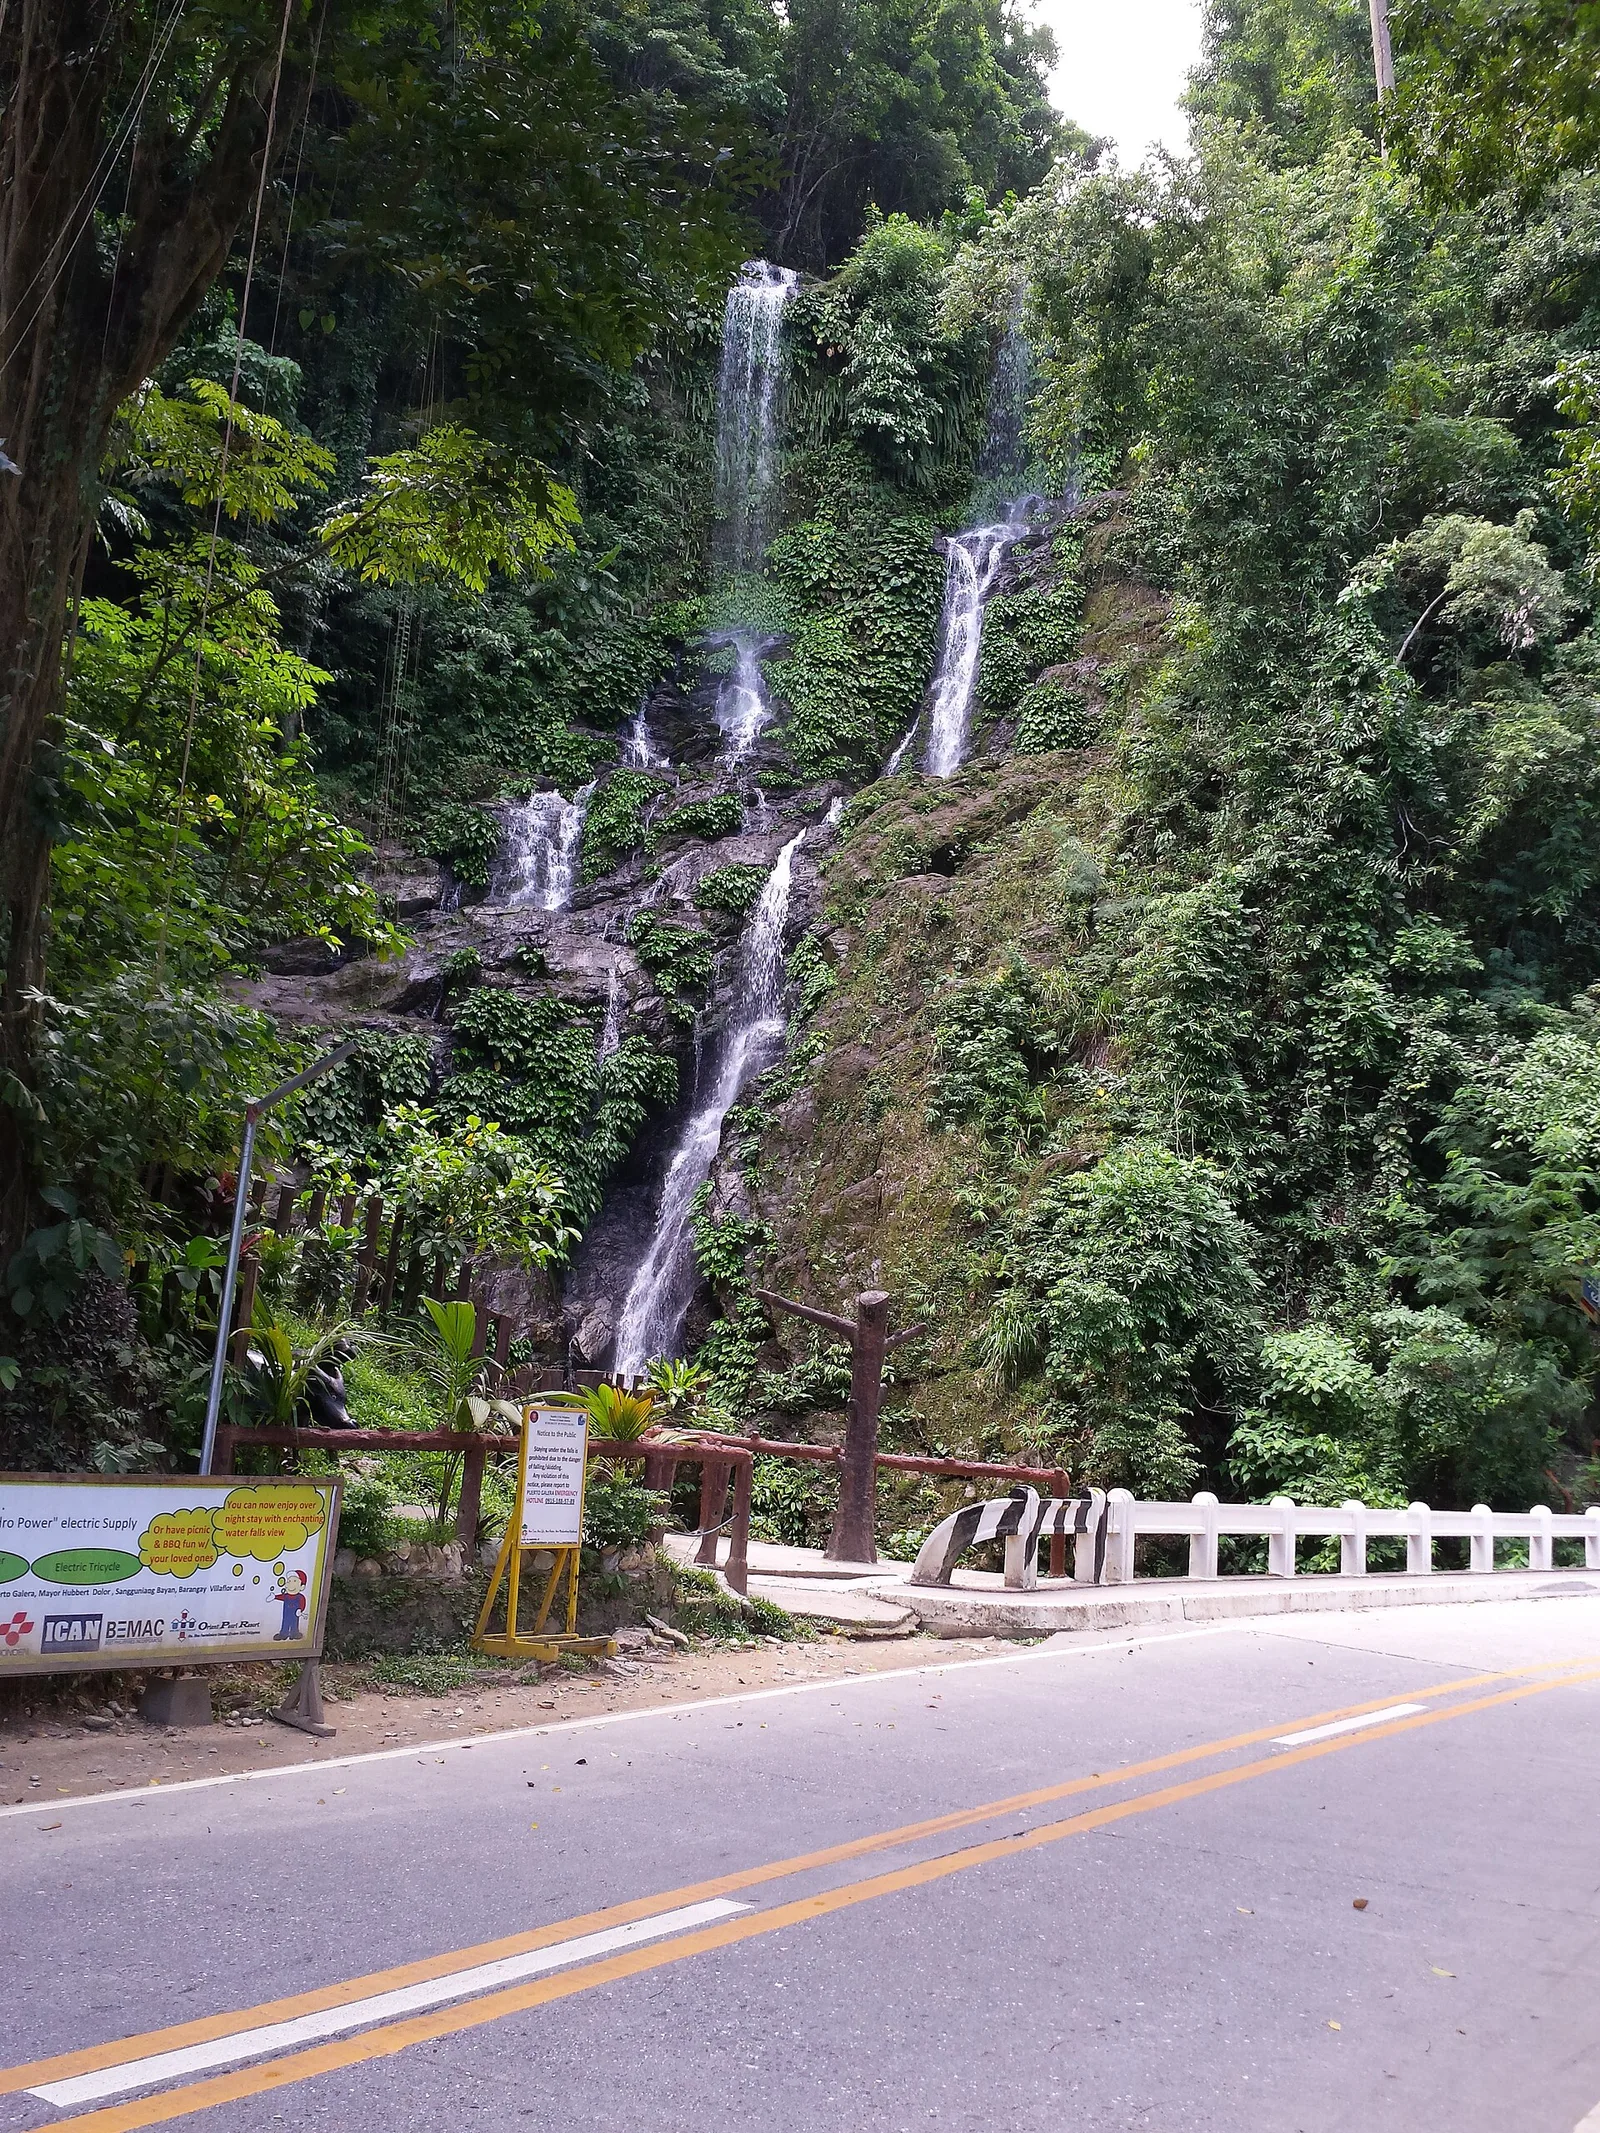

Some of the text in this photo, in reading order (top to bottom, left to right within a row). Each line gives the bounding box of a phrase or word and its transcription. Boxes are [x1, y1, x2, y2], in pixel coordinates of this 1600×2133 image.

[227, 1501, 242, 1509] You
[277, 1501, 298, 1511] enjoy
[17, 1517, 58, 1528] Power"
[61, 1517, 100, 1529] electric
[102, 1517, 137, 1531] Supply
[225, 1515, 324, 1526] night stay with enchanting
[153, 1526, 210, 1536] Or have picnic
[226, 1529, 285, 1538] water falls view
[154, 1539, 210, 1549] & BBQ fun w/
[150, 1554, 214, 1564] your loved ones
[55, 1562, 120, 1574] Electric Tricycle
[12, 1590, 37, 1599] Galera,
[38, 1589, 60, 1598] Mayor
[62, 1588, 89, 1597] Hubbert
[157, 1586, 177, 1595] Bayan,
[179, 1585, 207, 1594] Barangay
[210, 1584, 233, 1592] Villaflor
[234, 1584, 245, 1592] and
[44, 1620, 101, 1642] ICAN
[105, 1619, 165, 1639] BEMAC
